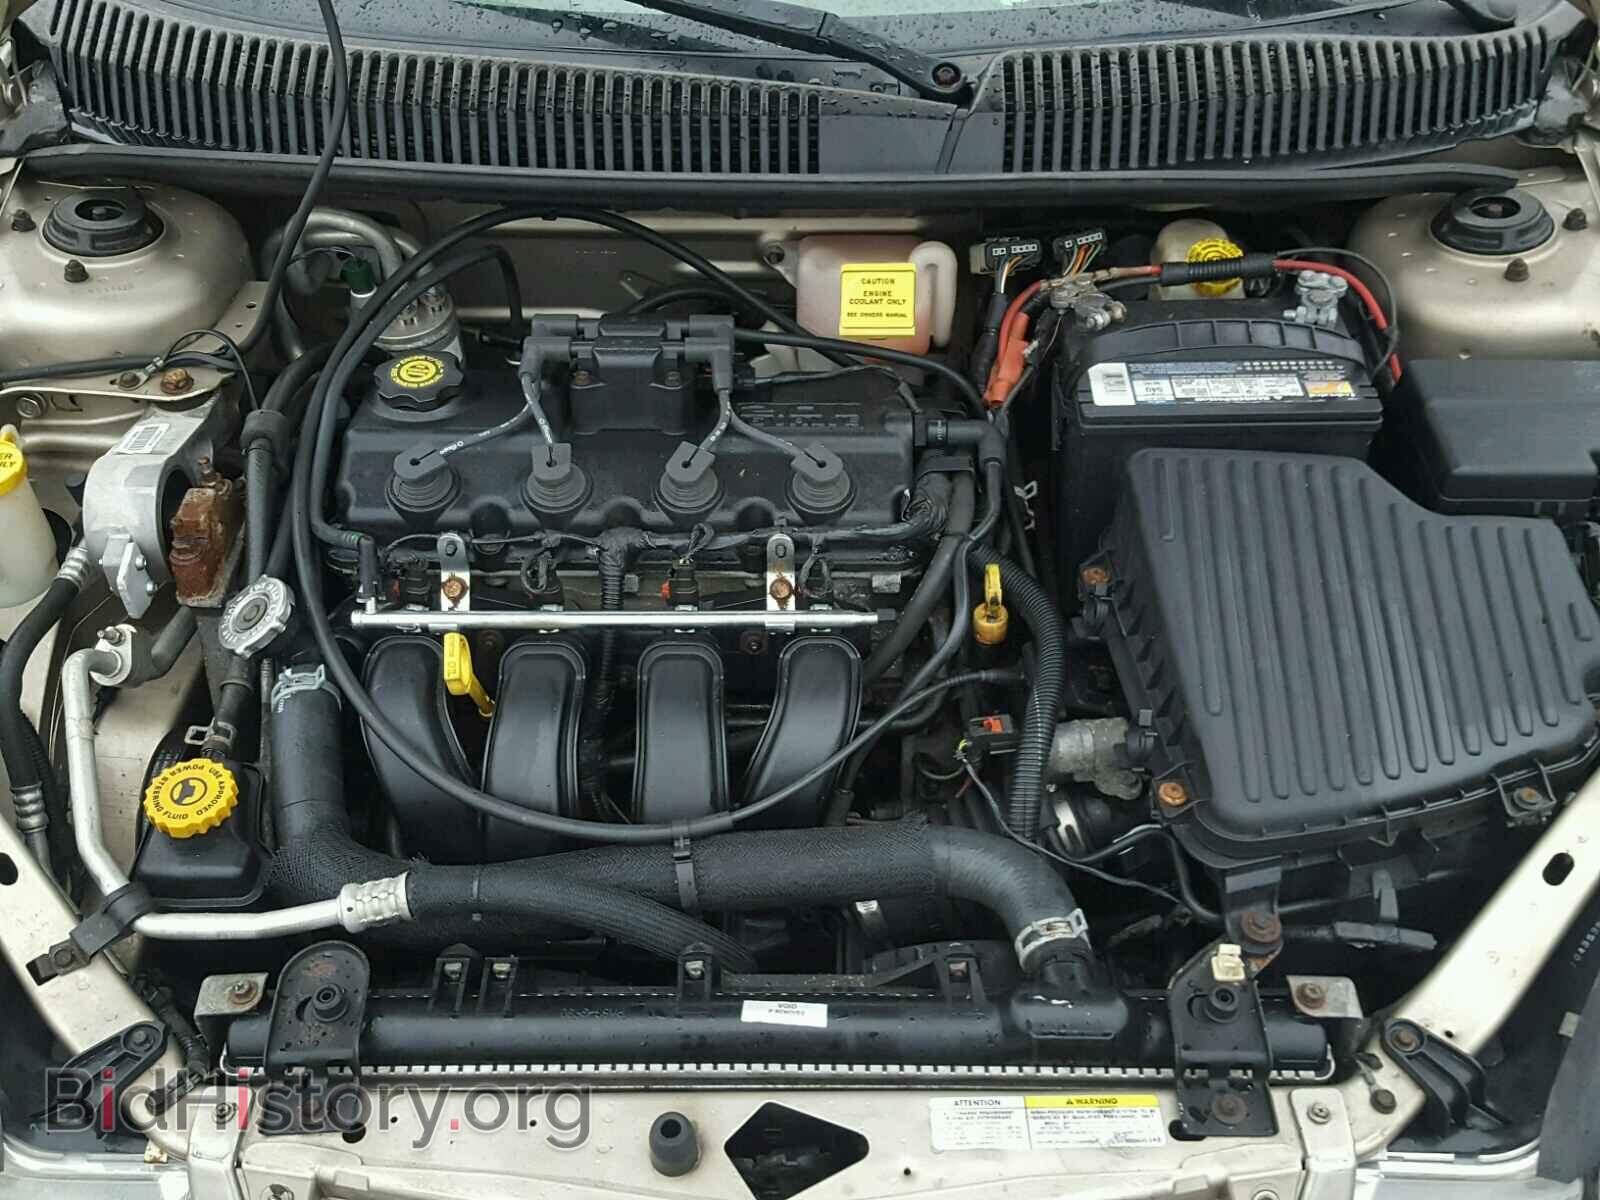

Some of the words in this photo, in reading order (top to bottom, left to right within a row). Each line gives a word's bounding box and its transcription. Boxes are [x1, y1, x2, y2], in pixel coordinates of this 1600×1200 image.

[168, 763, 205, 777] POWER
[152, 776, 169, 812] STEERING
[195, 780, 226, 816] APPROVED
[162, 811, 190, 820] FLUID
[1075, 1097, 1118, 1105] WARNING
